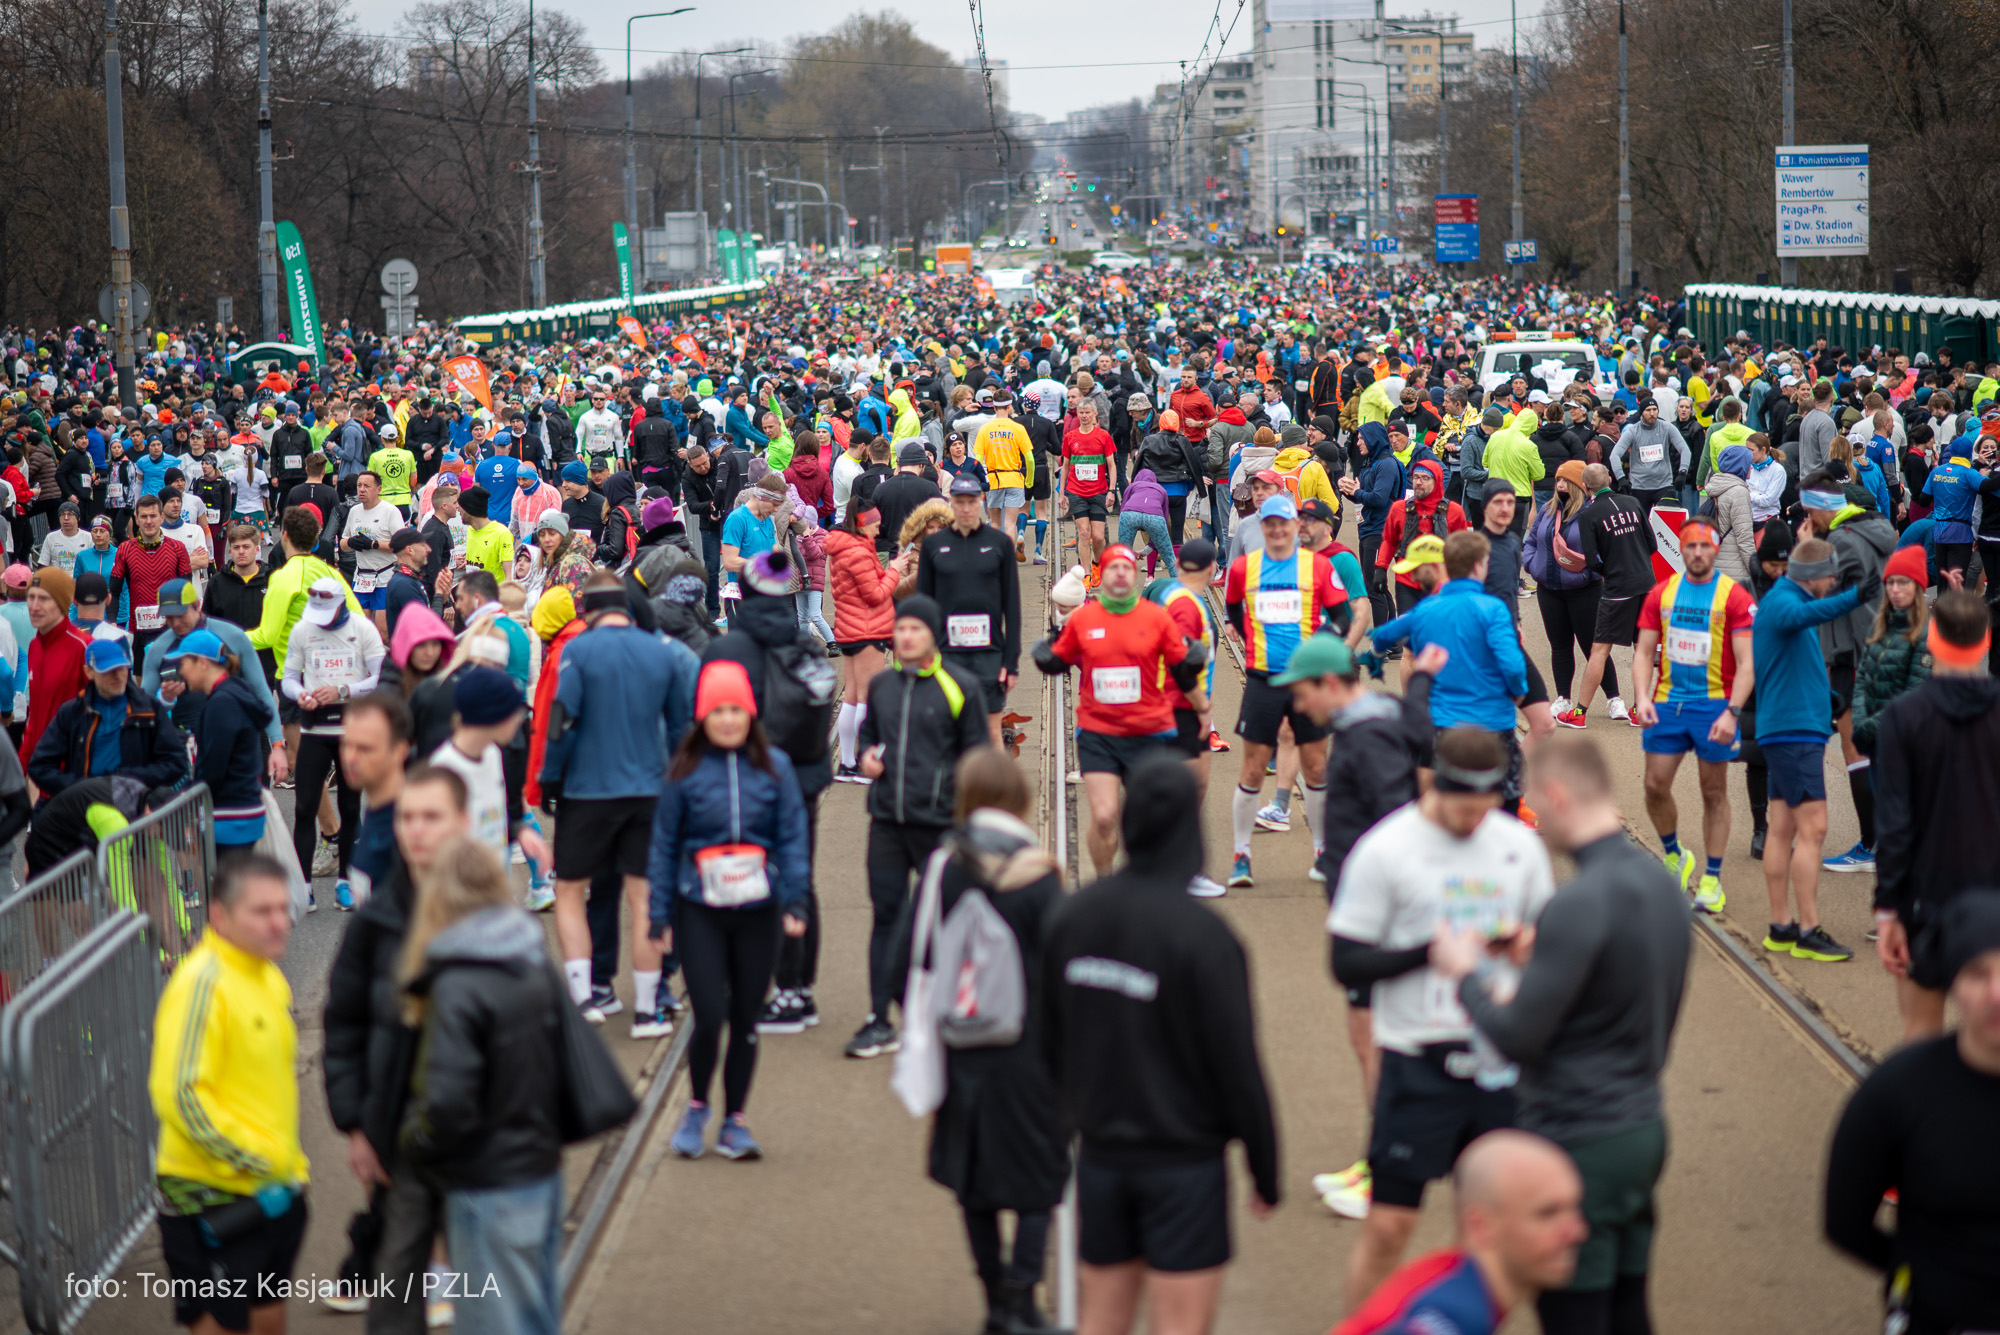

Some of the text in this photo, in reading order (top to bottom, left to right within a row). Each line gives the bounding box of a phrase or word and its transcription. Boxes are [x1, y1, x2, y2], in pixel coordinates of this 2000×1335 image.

[1798, 154, 1860, 166] Poniatowskiego
[1781, 174, 1814, 184] Wawer
[1780, 187, 1834, 198] Rembertów
[1780, 204, 1828, 216] Praga-Pn.
[1794, 220, 1852, 230] Dw. Stadion
[1794, 234, 1863, 245] Dw. Wschodni
[990, 431, 1014, 440] START!
[1933, 474, 1959, 484] ZBYSZEK
[1602, 511, 1639, 532] LEGIA
[960, 626, 980, 635] 3000
[1678, 640, 1696, 652] 4811
[324, 659, 343, 668] 2541
